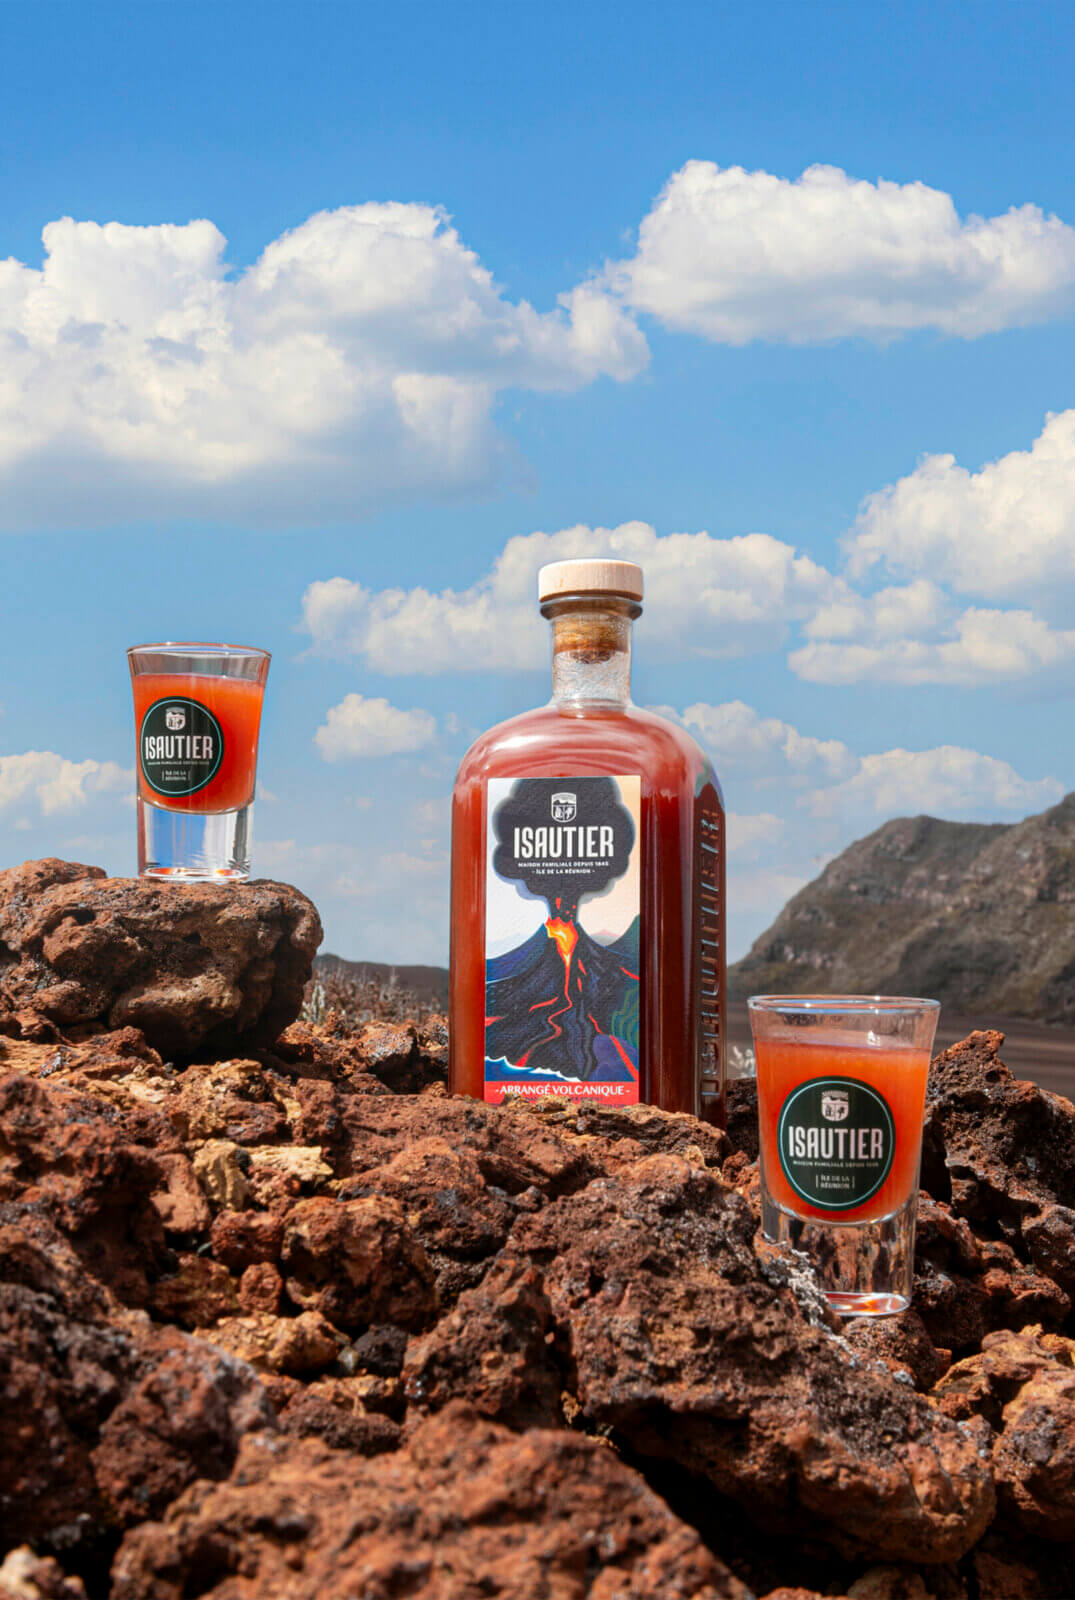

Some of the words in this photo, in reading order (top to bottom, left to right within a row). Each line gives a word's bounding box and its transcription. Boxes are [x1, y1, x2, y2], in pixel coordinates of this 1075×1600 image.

[145, 735, 213, 760] ISAUTIER
[513, 825, 614, 859] ISAUTIER
[499, 1084, 550, 1095] ARRANGÉ
[552, 1085, 625, 1097] VOLCANIQUE
[788, 1126, 884, 1159] ISAUTIER
